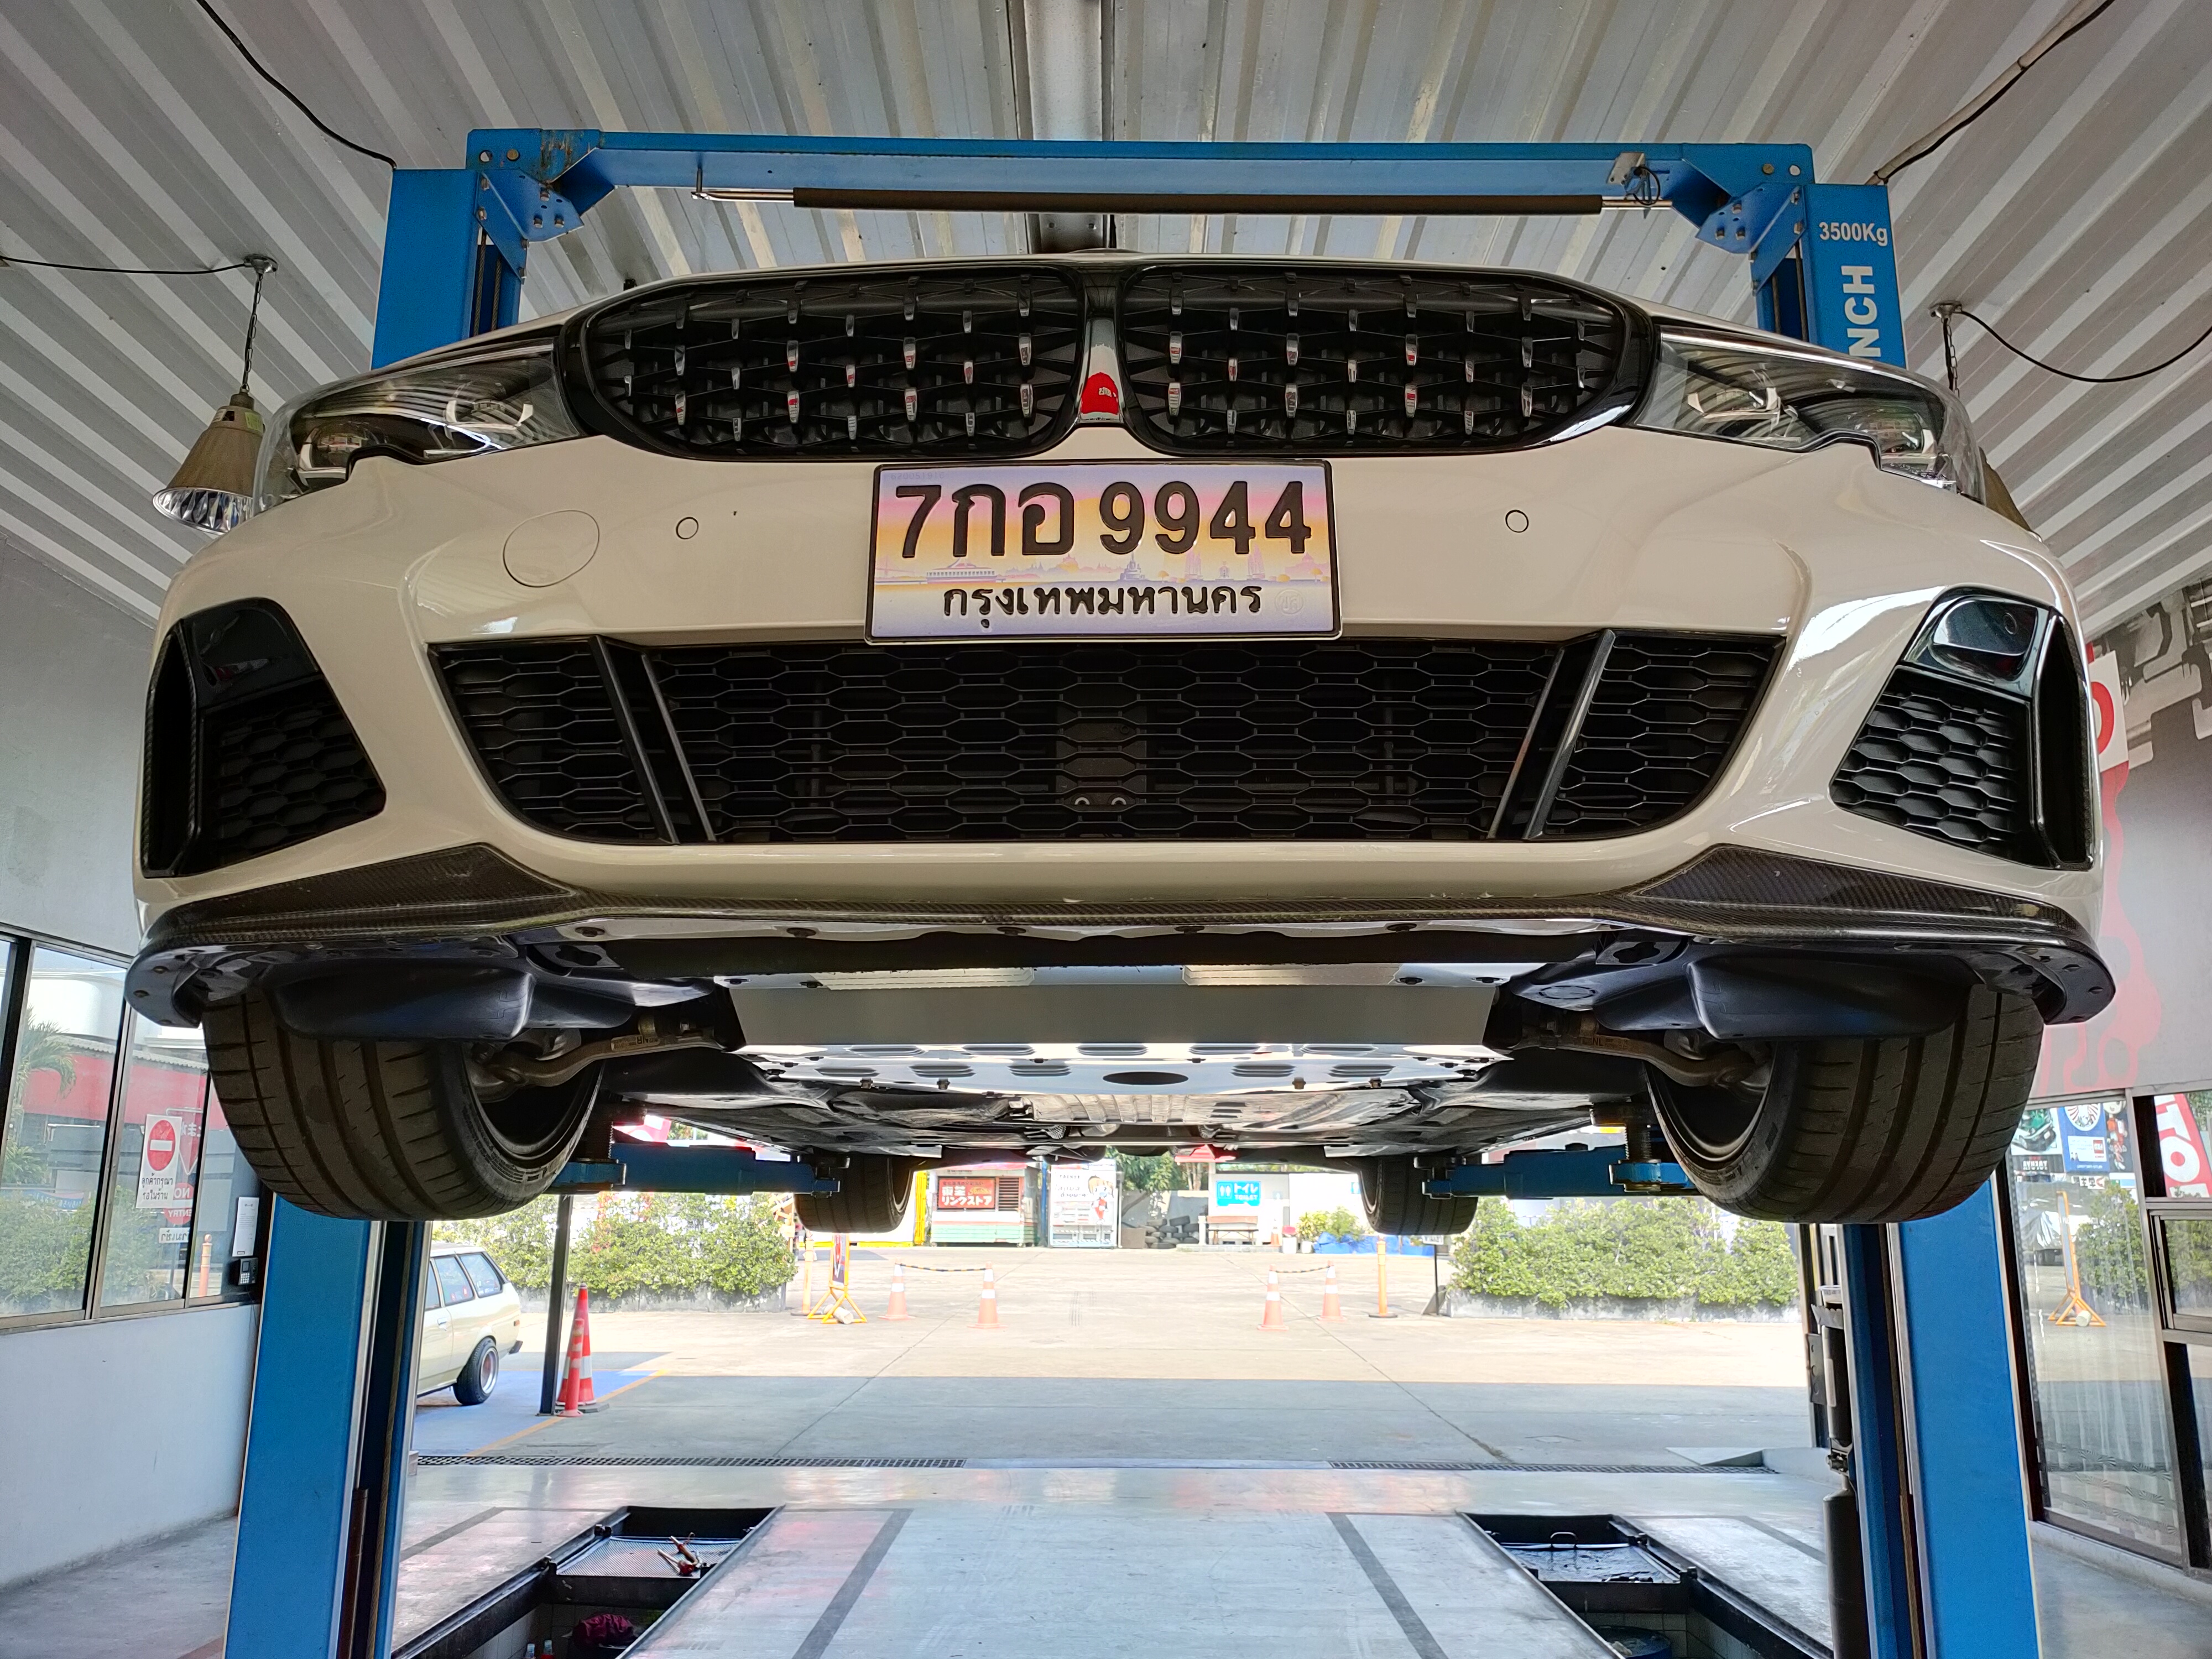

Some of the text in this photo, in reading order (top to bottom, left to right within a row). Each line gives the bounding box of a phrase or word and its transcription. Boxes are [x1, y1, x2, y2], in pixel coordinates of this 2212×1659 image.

[1819, 222, 1888, 247] 3500Kg
[895, 481, 1312, 559] 7กอ 9944
[943, 585, 1262, 628] กรุงเทพมหานคร
[142, 1172, 173, 1188] ลูกค้ากรุณา
[1234, 1183, 1258, 1193] トイレ
[143, 1188, 168, 1200] รอในร้าน
[942, 1196, 992, 1206] リンクストア
